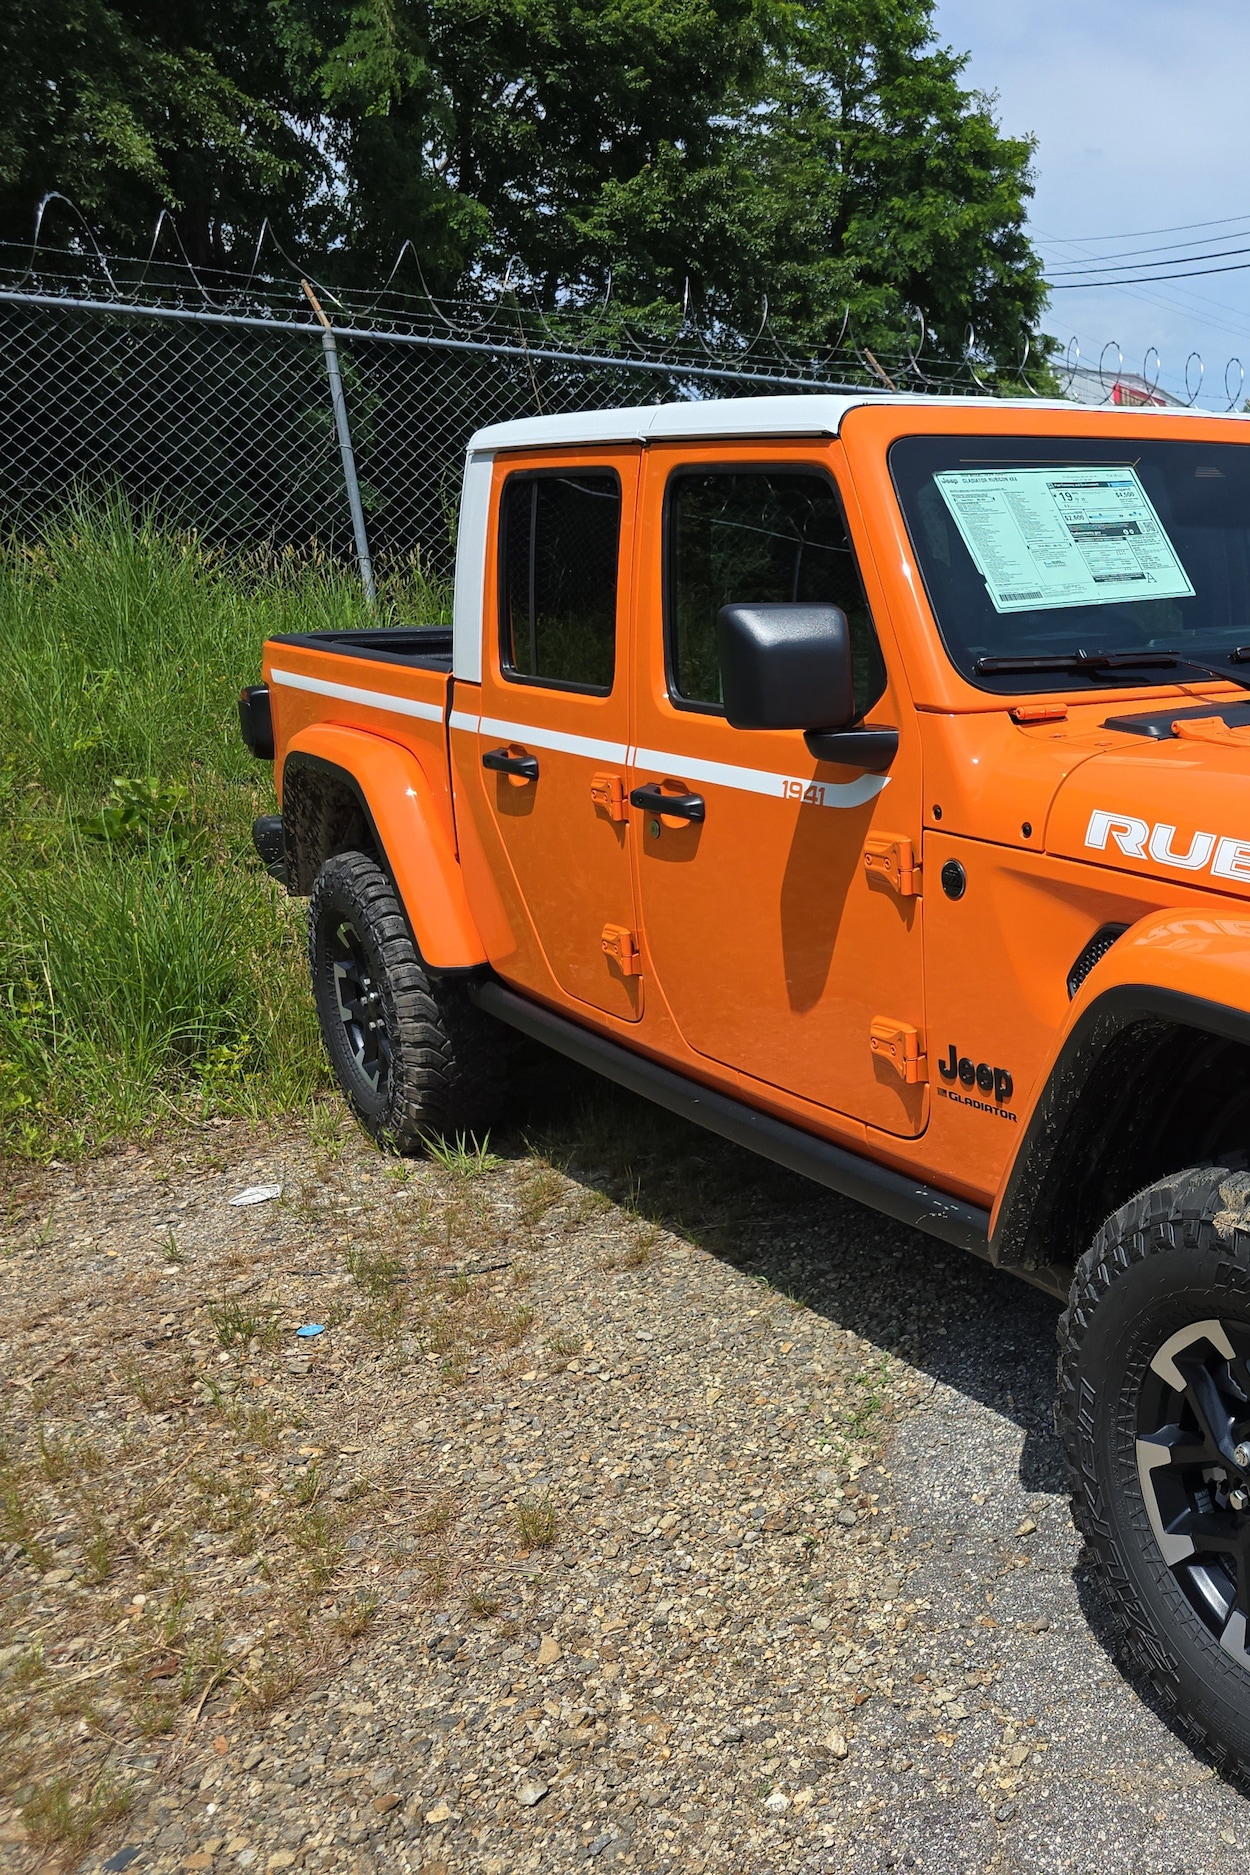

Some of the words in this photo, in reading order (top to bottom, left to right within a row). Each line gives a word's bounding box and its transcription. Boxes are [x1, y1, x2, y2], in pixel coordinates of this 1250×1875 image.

[1059, 491, 1073, 502] 19
[782, 780, 826, 805] 1941
[938, 1044, 1013, 1103] Jeep
[948, 1091, 1018, 1123] GLADIATOR
